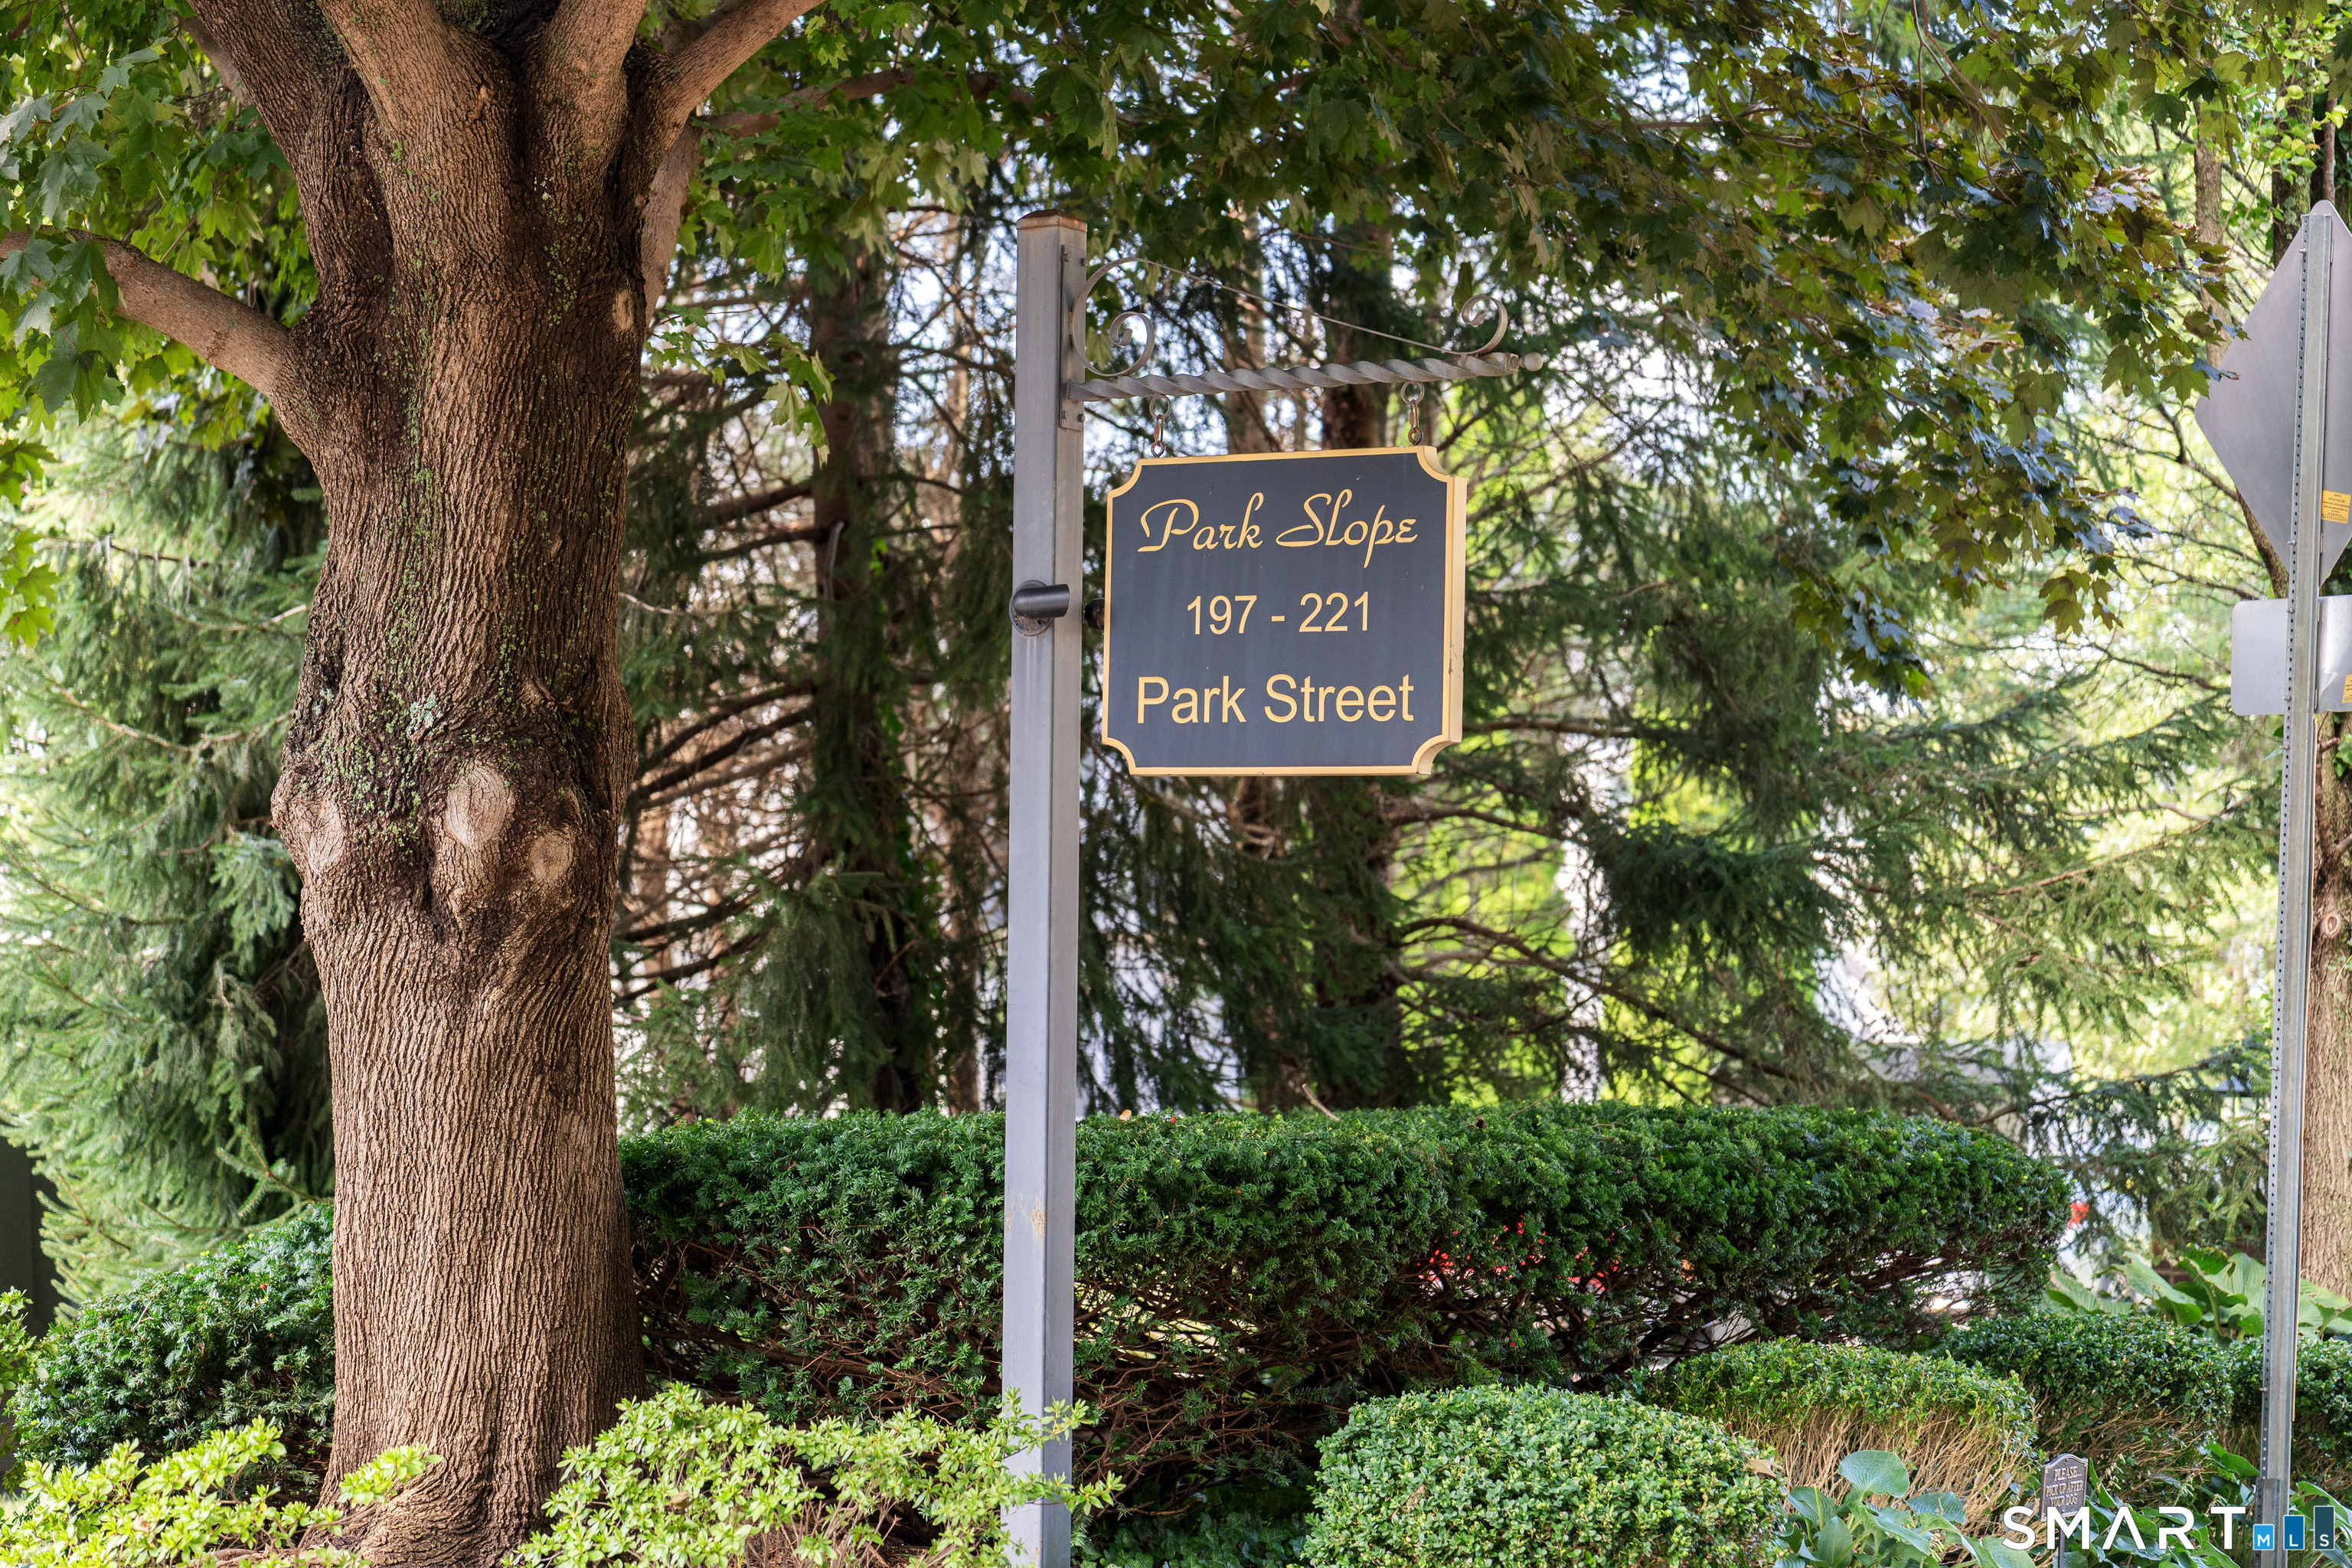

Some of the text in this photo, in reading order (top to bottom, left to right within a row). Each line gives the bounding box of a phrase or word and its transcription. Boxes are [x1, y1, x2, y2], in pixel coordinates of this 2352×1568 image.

[1137, 488, 1418, 569] Park Slope
[1187, 594, 1258, 635] 197
[1298, 591, 1369, 632] 221
[1137, 673, 1414, 724] Park Street
[2046, 1480, 2083, 1497] PICK UP AFTER
[2050, 1492, 2077, 1507] YOUR DOG
